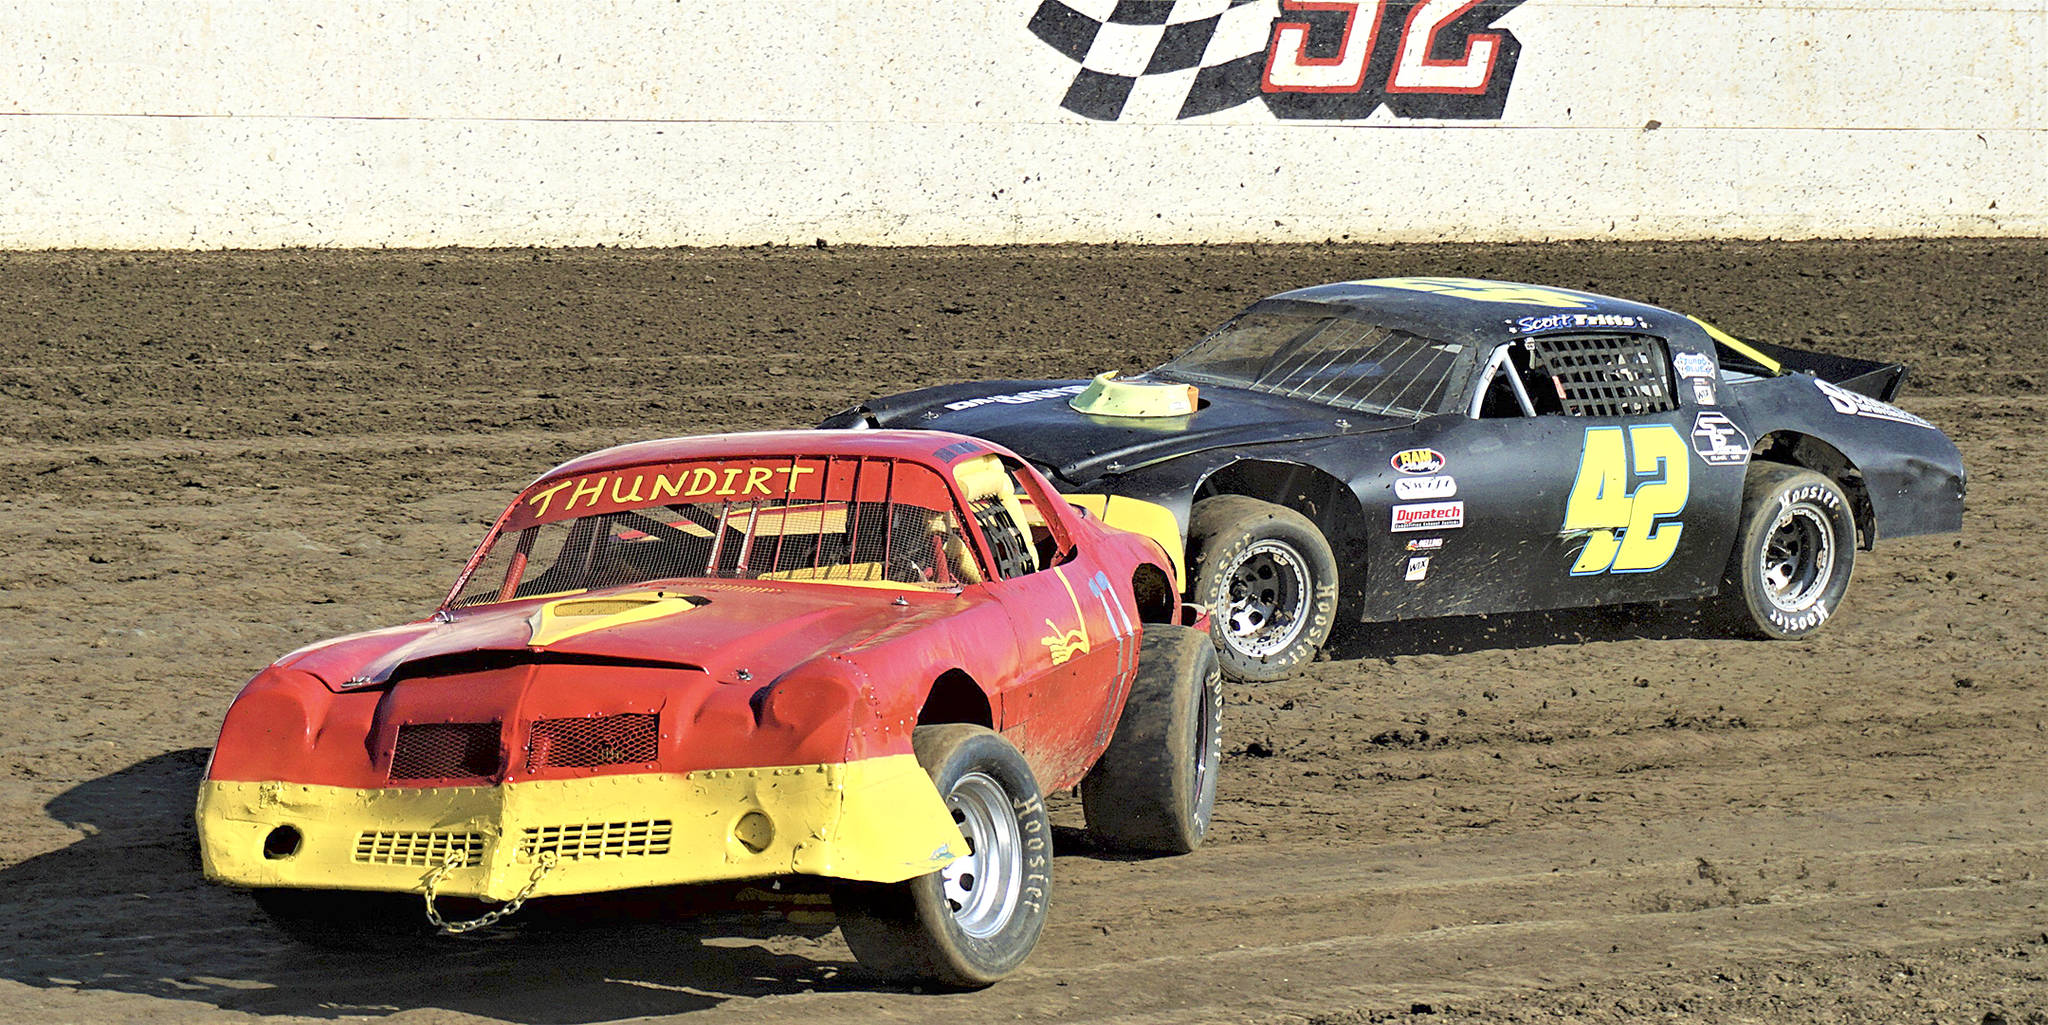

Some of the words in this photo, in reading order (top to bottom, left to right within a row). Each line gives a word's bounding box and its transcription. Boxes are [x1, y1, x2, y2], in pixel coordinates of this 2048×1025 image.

[1518, 315, 1571, 332] Scott
[529, 468, 815, 519] THUNDIRT
[1561, 424, 1690, 576] 42
[1779, 483, 1840, 509] Hoosier
[1396, 506, 1461, 525] Dynatech
[1278, 578, 1335, 666] Hoosier
[1770, 600, 1829, 634] Hoosier
[1013, 793, 1048, 913] Hoosier
